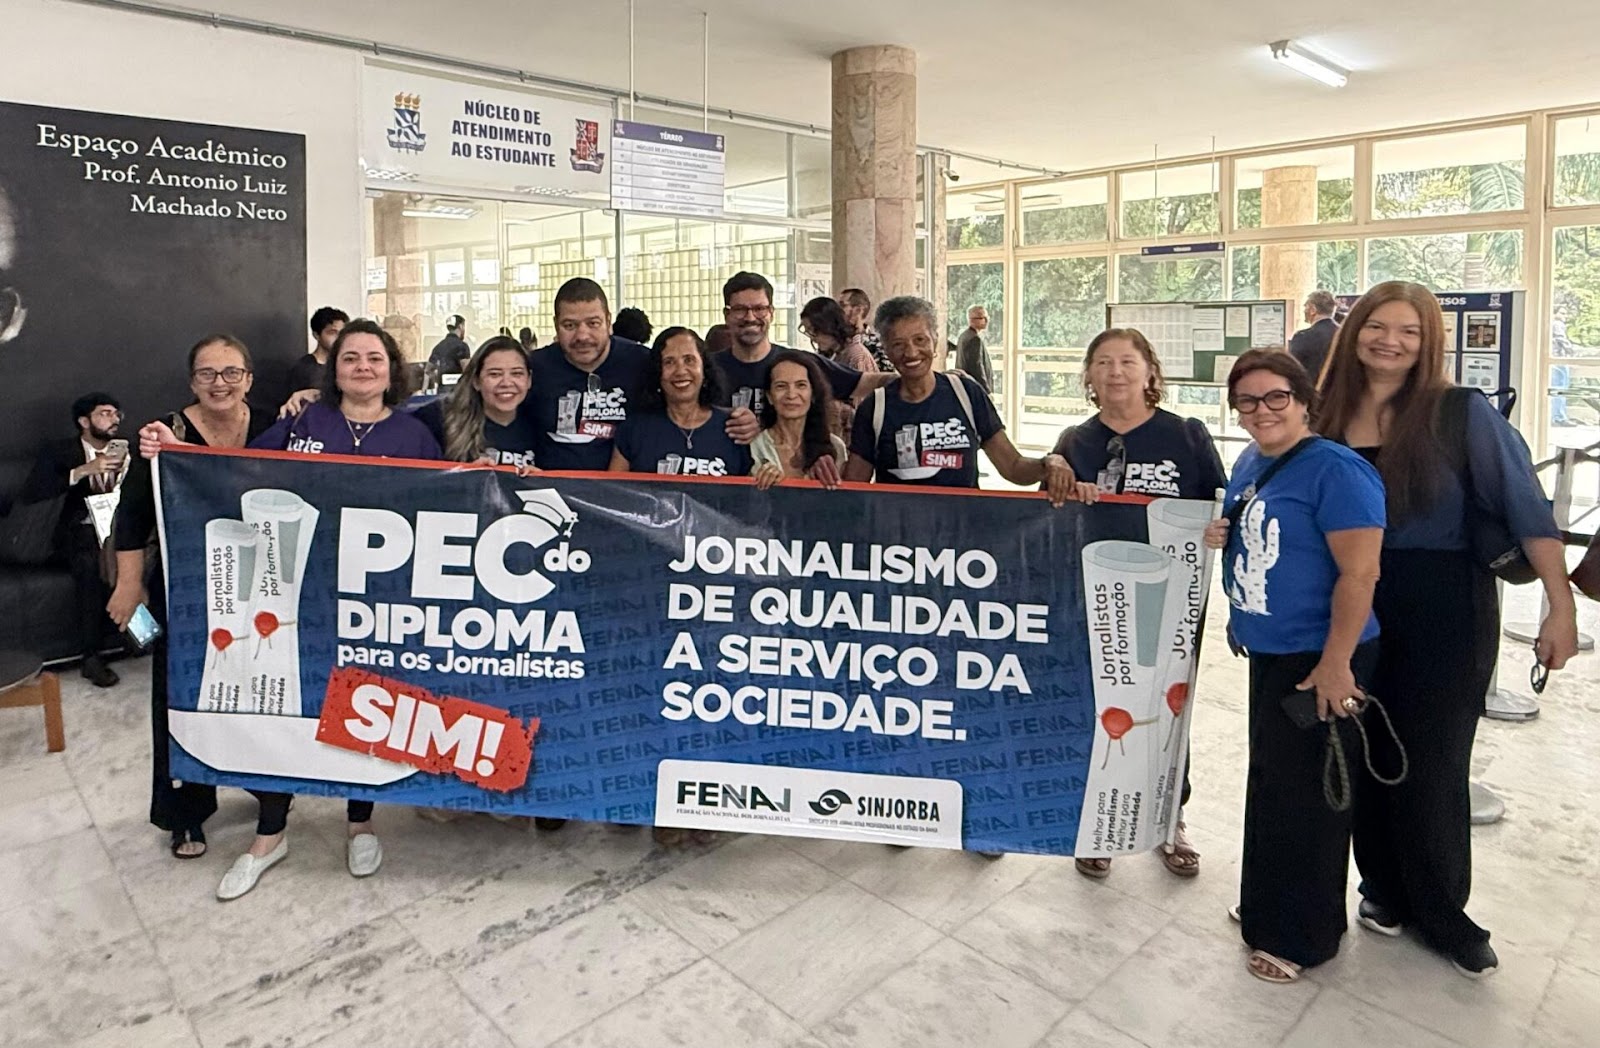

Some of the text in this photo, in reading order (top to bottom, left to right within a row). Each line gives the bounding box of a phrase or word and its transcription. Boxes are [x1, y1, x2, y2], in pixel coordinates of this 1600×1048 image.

[464, 98, 541, 126] NÚCLEO DE
[36, 123, 287, 170] Espaço Acadêmico
[451, 120, 552, 148] ATENDIMENTO
[451, 141, 556, 167] AO ESTUDANTE
[84, 161, 287, 195] Prof. Antonio Luiz
[130, 194, 287, 221] Machado Neto
[1437, 296, 1467, 306] ISOS
[582, 391, 621, 409] PEC
[583, 422, 612, 439] SIM!
[920, 421, 961, 439] PEC
[922, 434, 970, 447] DIPLOMA
[683, 457, 724, 477] PEC
[926, 453, 957, 468] SIM!
[1124, 462, 1174, 482] PEC
[1124, 479, 1180, 493] DIPLOMA
[337, 507, 560, 604] PEC
[543, 541, 592, 573] do
[668, 535, 998, 589] JORNALISMO
[211, 547, 224, 615] Jornalistas
[224, 545, 236, 615] por formação
[270, 577, 281, 597] por
[337, 598, 586, 654] DIPLOMA
[667, 583, 1049, 644] DE QUALIDADE
[1094, 583, 1118, 687] Jornalistas
[1110, 581, 1136, 686] por formação
[337, 644, 586, 679] para os Jornalistas
[662, 631, 1032, 695] A SERVIÇO DA
[660, 681, 967, 741] SOCIEDADE.
[344, 683, 506, 777] SIM!
[930, 751, 1008, 777] FENAJ
[677, 780, 791, 813] FENAJ
[857, 796, 941, 822] SINJORBA
[1121, 793, 1131, 817] para
[1093, 791, 1107, 851] Melhor para
[1104, 788, 1119, 844] jornalismo
[1129, 791, 1142, 842] sociedade
